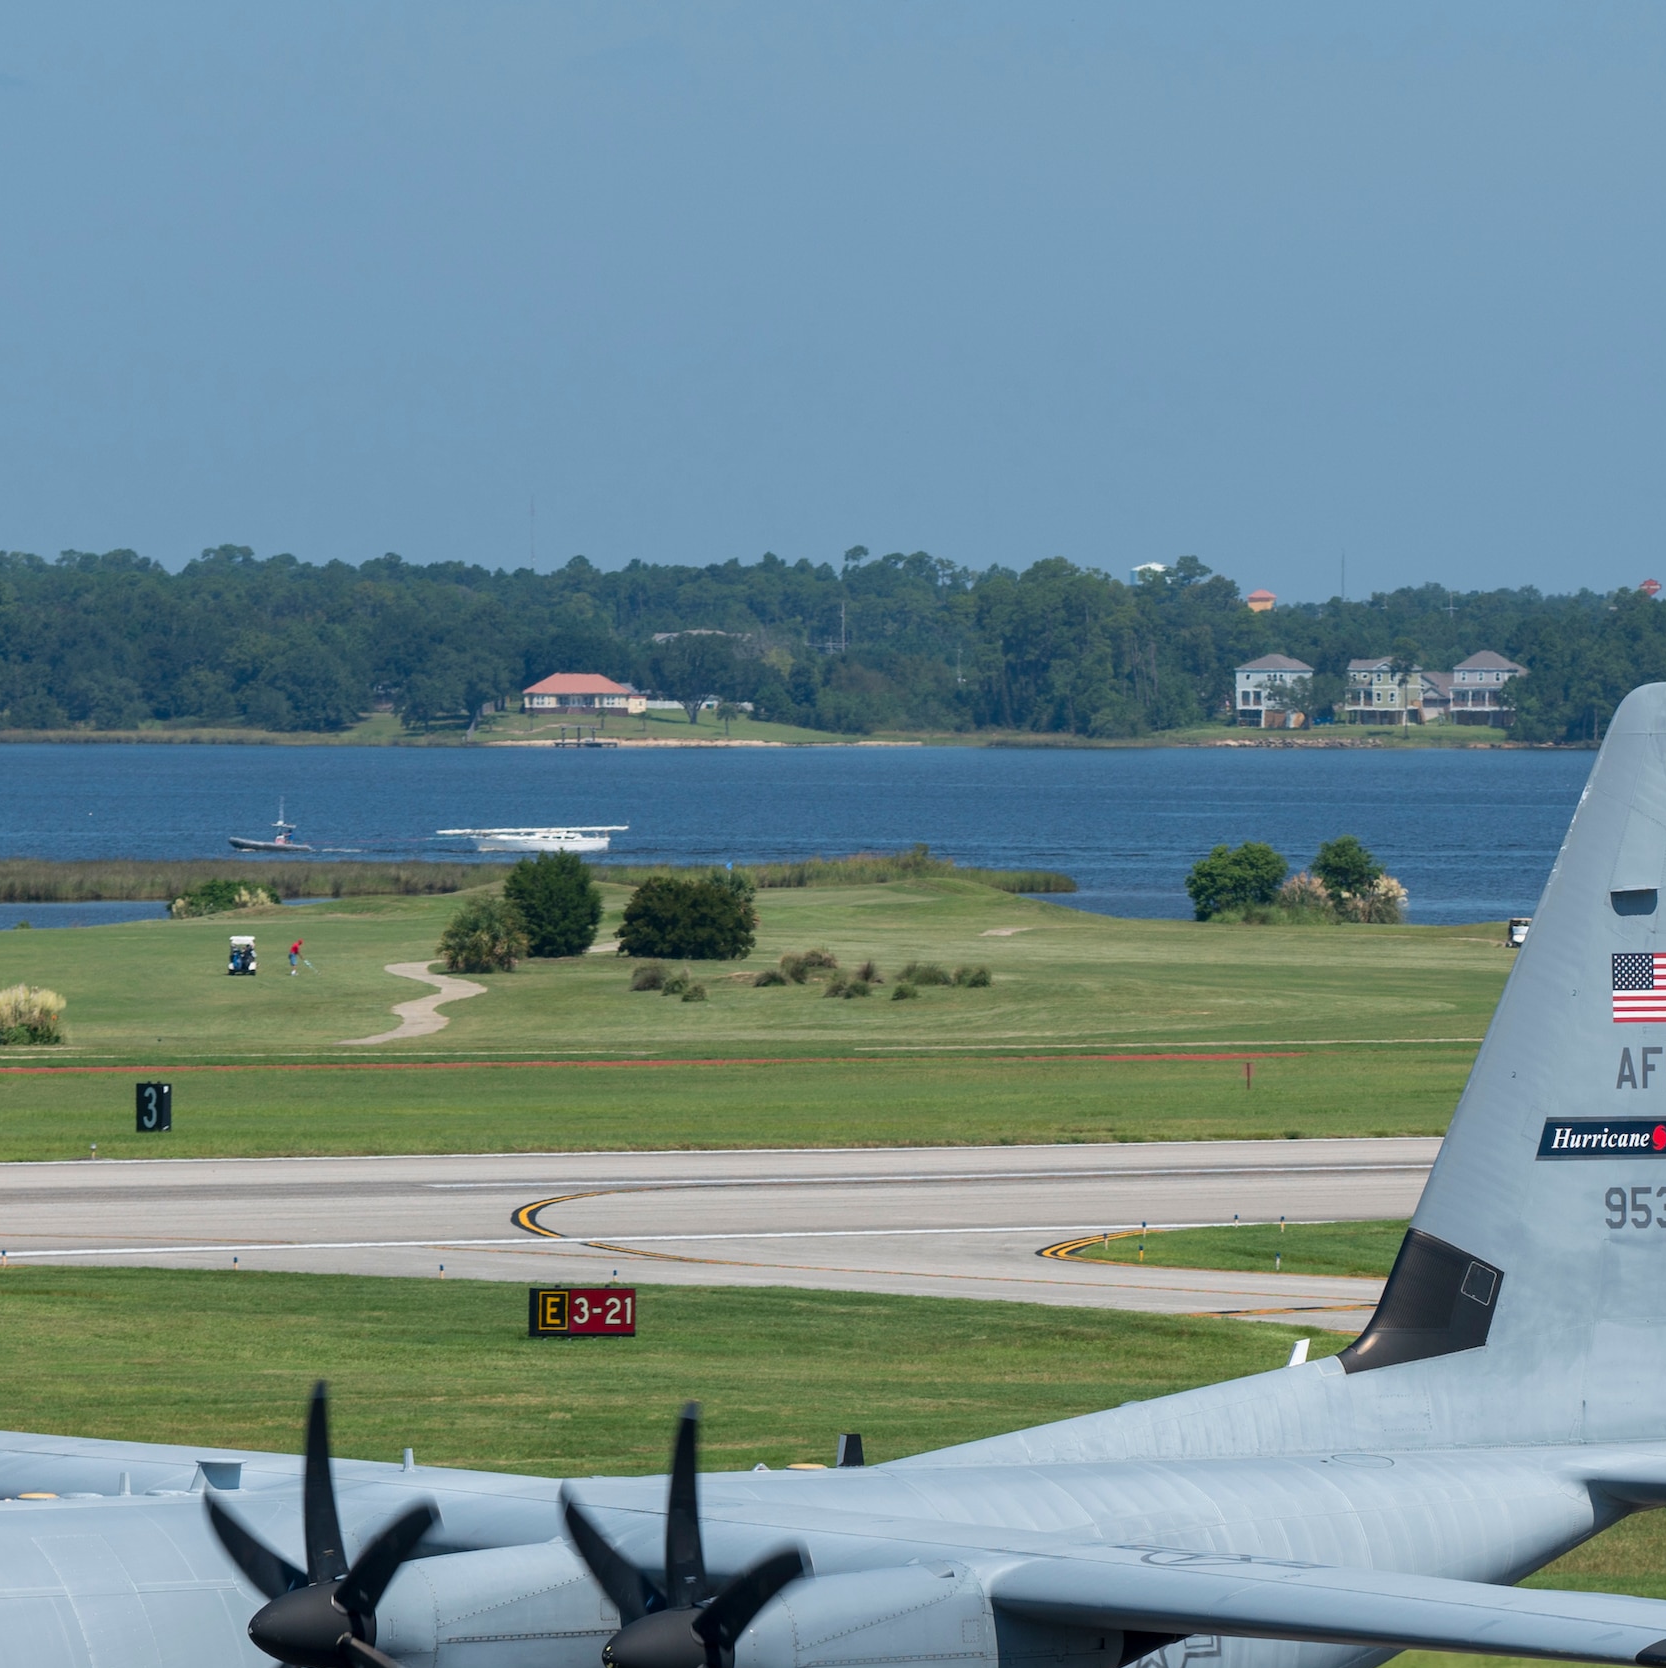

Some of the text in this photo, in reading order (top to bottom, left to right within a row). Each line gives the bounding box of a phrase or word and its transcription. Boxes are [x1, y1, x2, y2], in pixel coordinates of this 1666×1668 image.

[143, 1086, 157, 1128] 3
[1551, 1127, 1650, 1149] Hurricane
[546, 1297, 632, 1324] E 3-21
